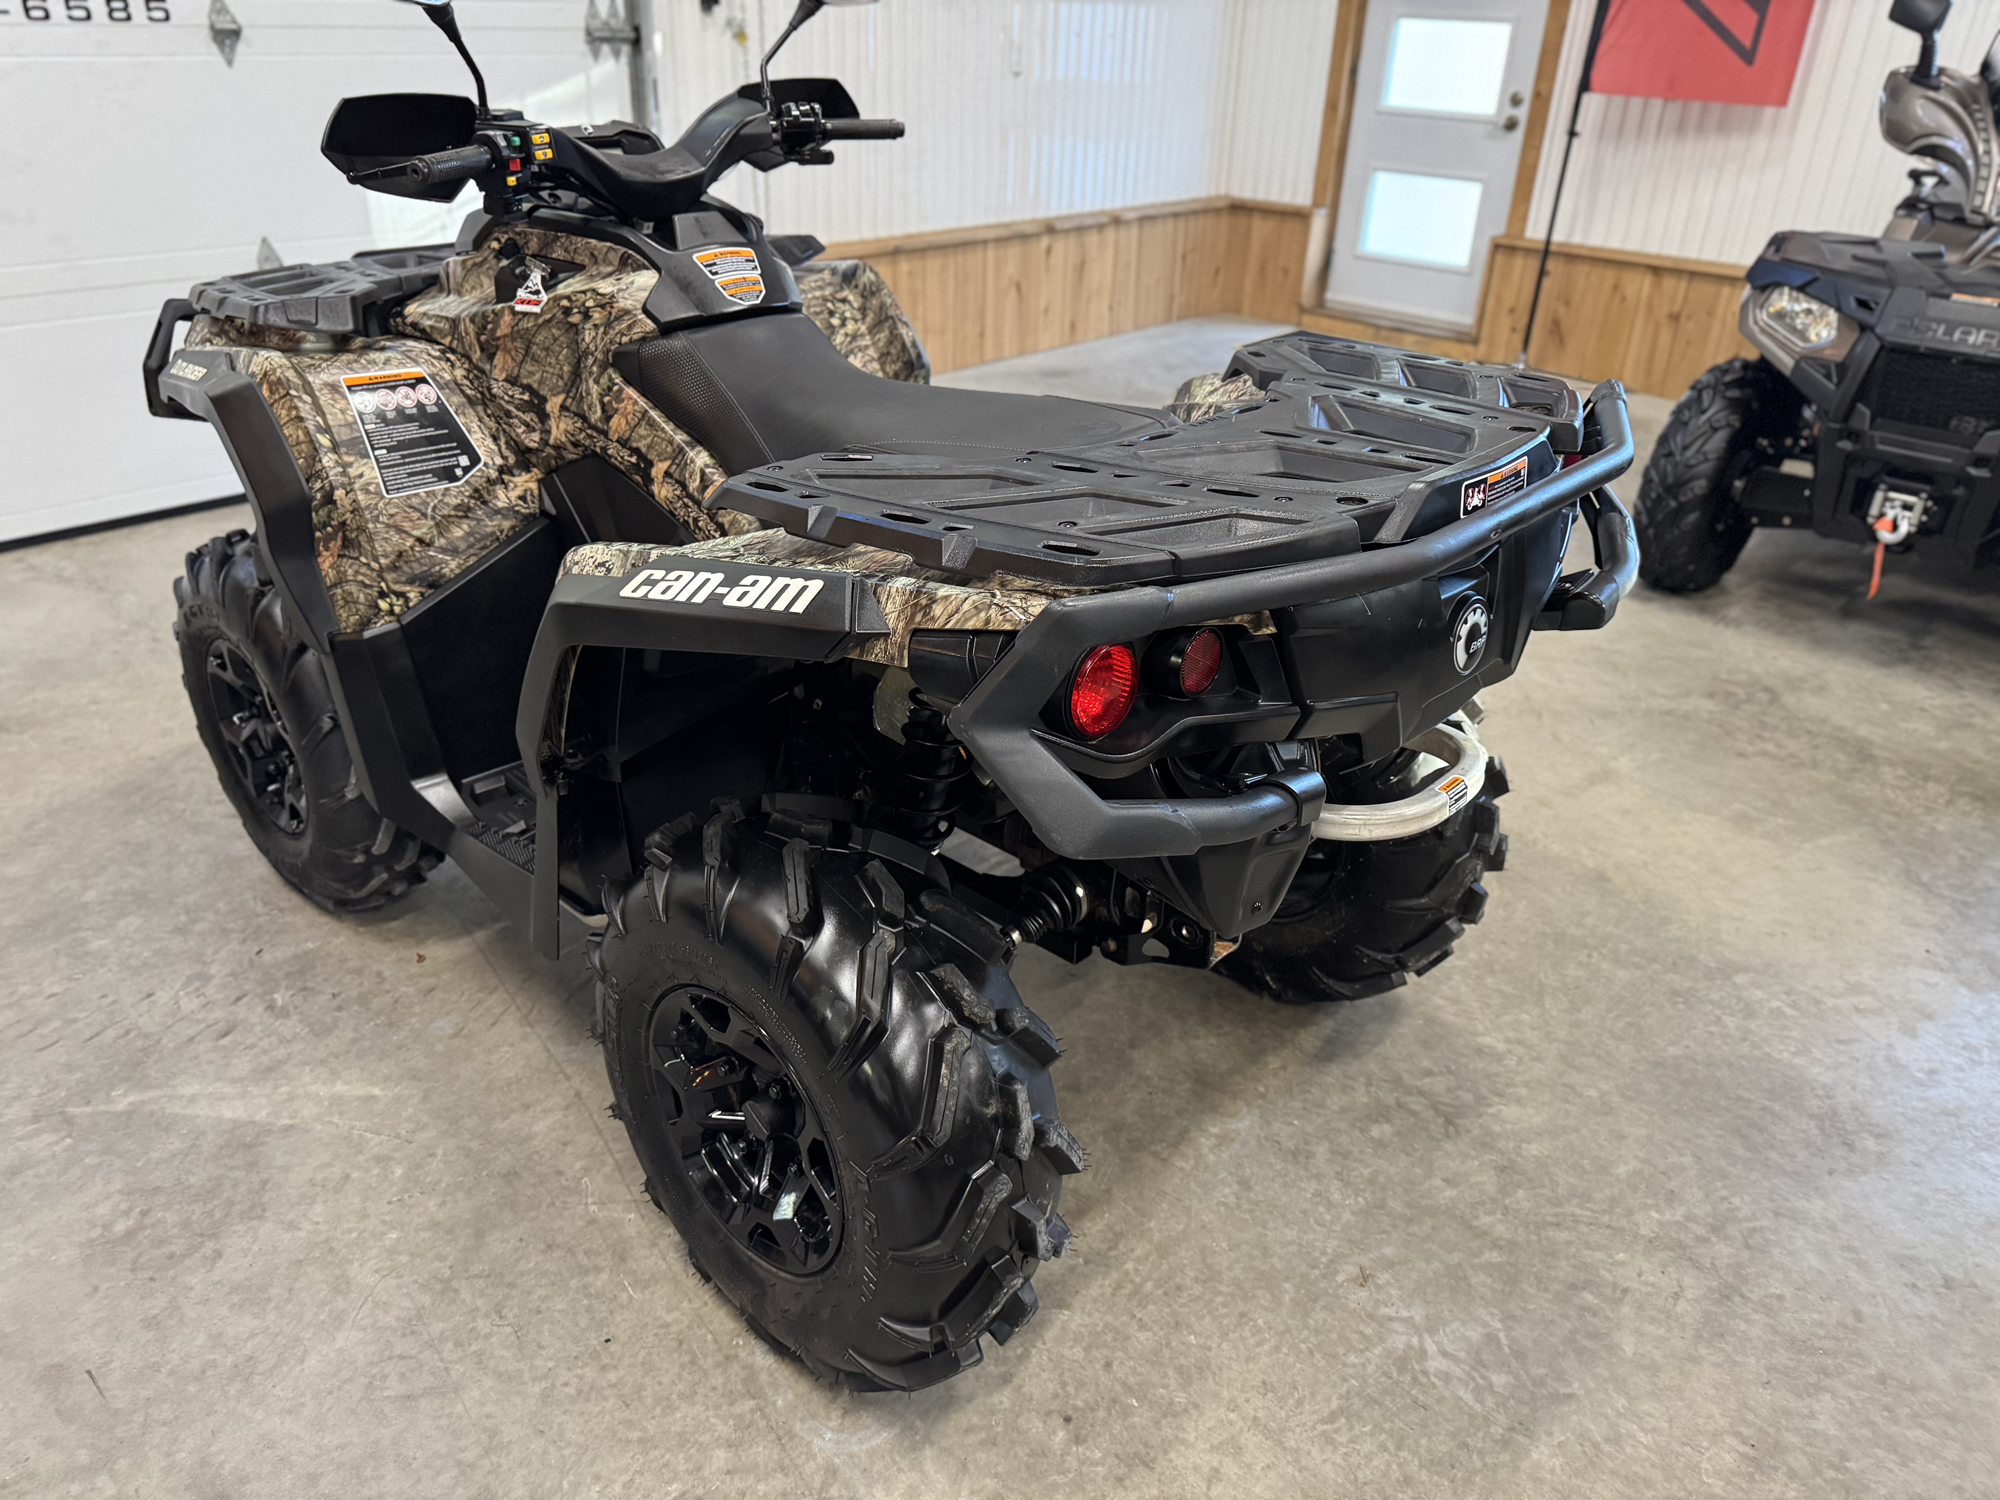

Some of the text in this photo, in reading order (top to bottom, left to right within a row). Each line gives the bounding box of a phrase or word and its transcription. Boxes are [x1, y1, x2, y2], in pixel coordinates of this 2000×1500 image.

[170, 359, 208, 381] OUTLANDER
[619, 569, 824, 614] can-am
[1469, 634, 1487, 653] BRP
